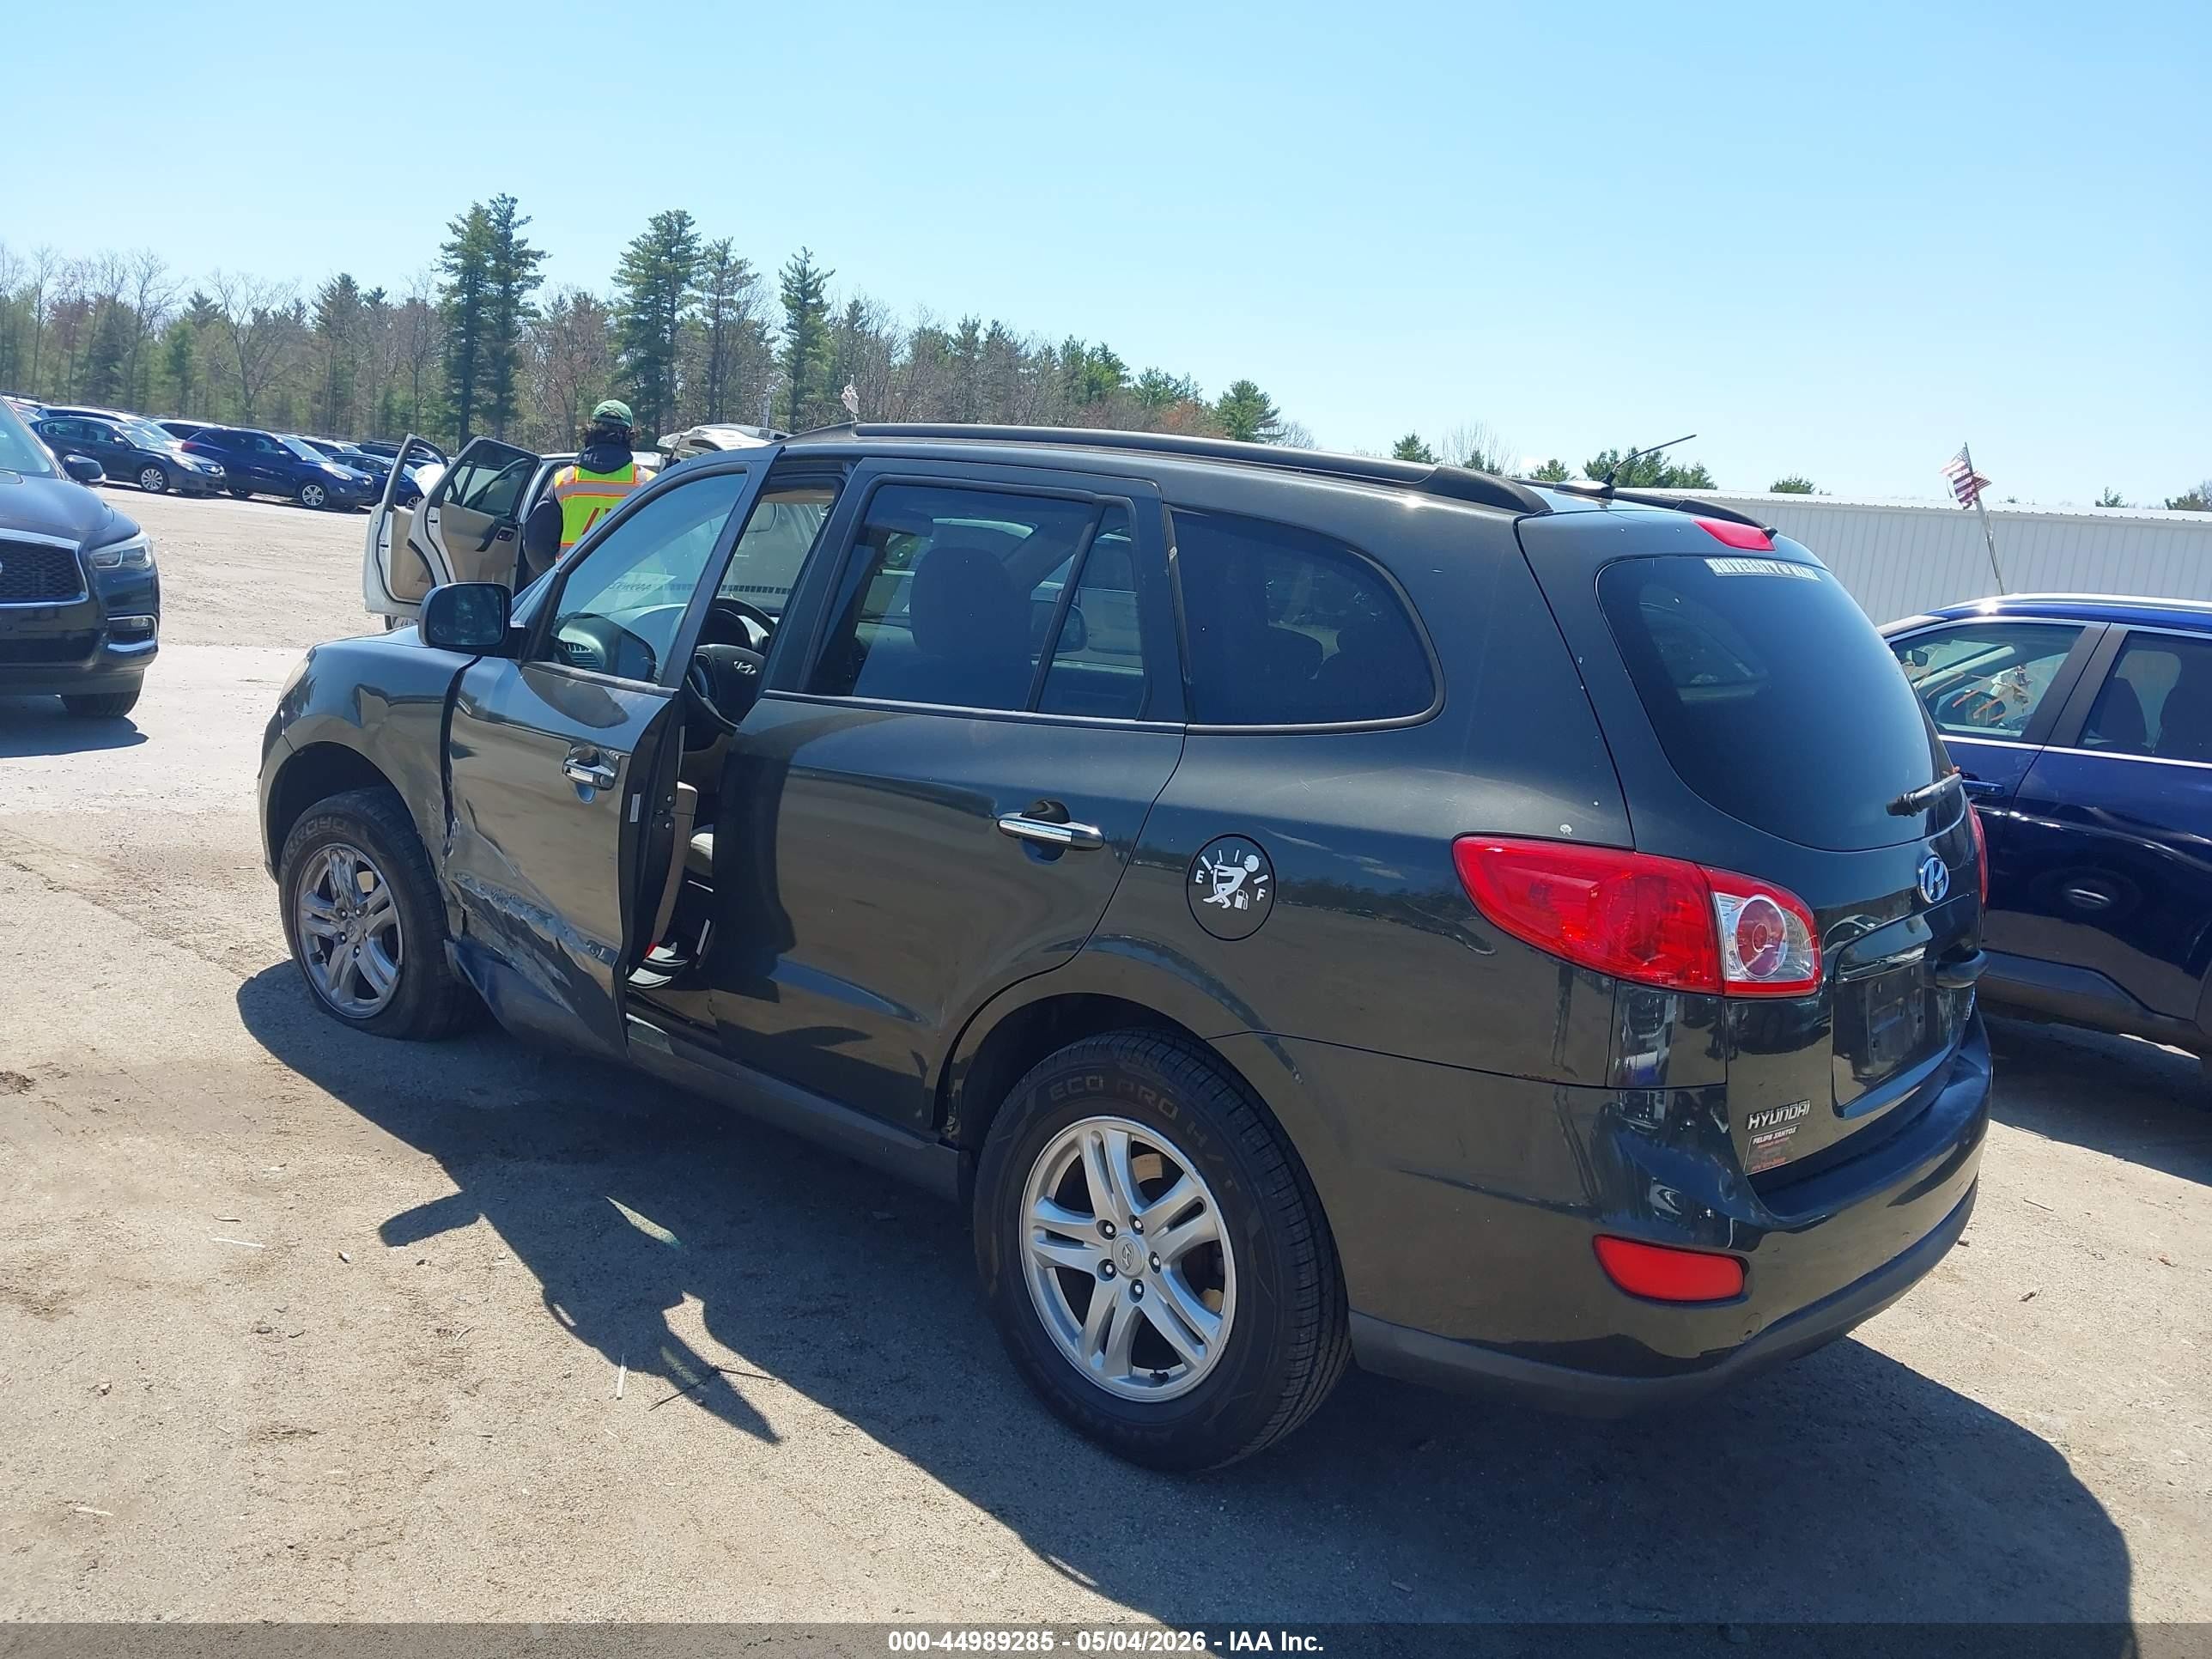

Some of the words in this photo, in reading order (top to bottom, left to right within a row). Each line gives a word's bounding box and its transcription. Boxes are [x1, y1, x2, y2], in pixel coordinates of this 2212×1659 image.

[1194, 870, 1205, 884] E
[1256, 888, 1267, 902] F
[1049, 1074, 1105, 1102] ECO
[1115, 1077, 1179, 1121] PRO
[1747, 1100, 1810, 1130] HYUNDAI
[1753, 1133, 1774, 1146] FELIPE
[1773, 1126, 1797, 1140] SANTOS
